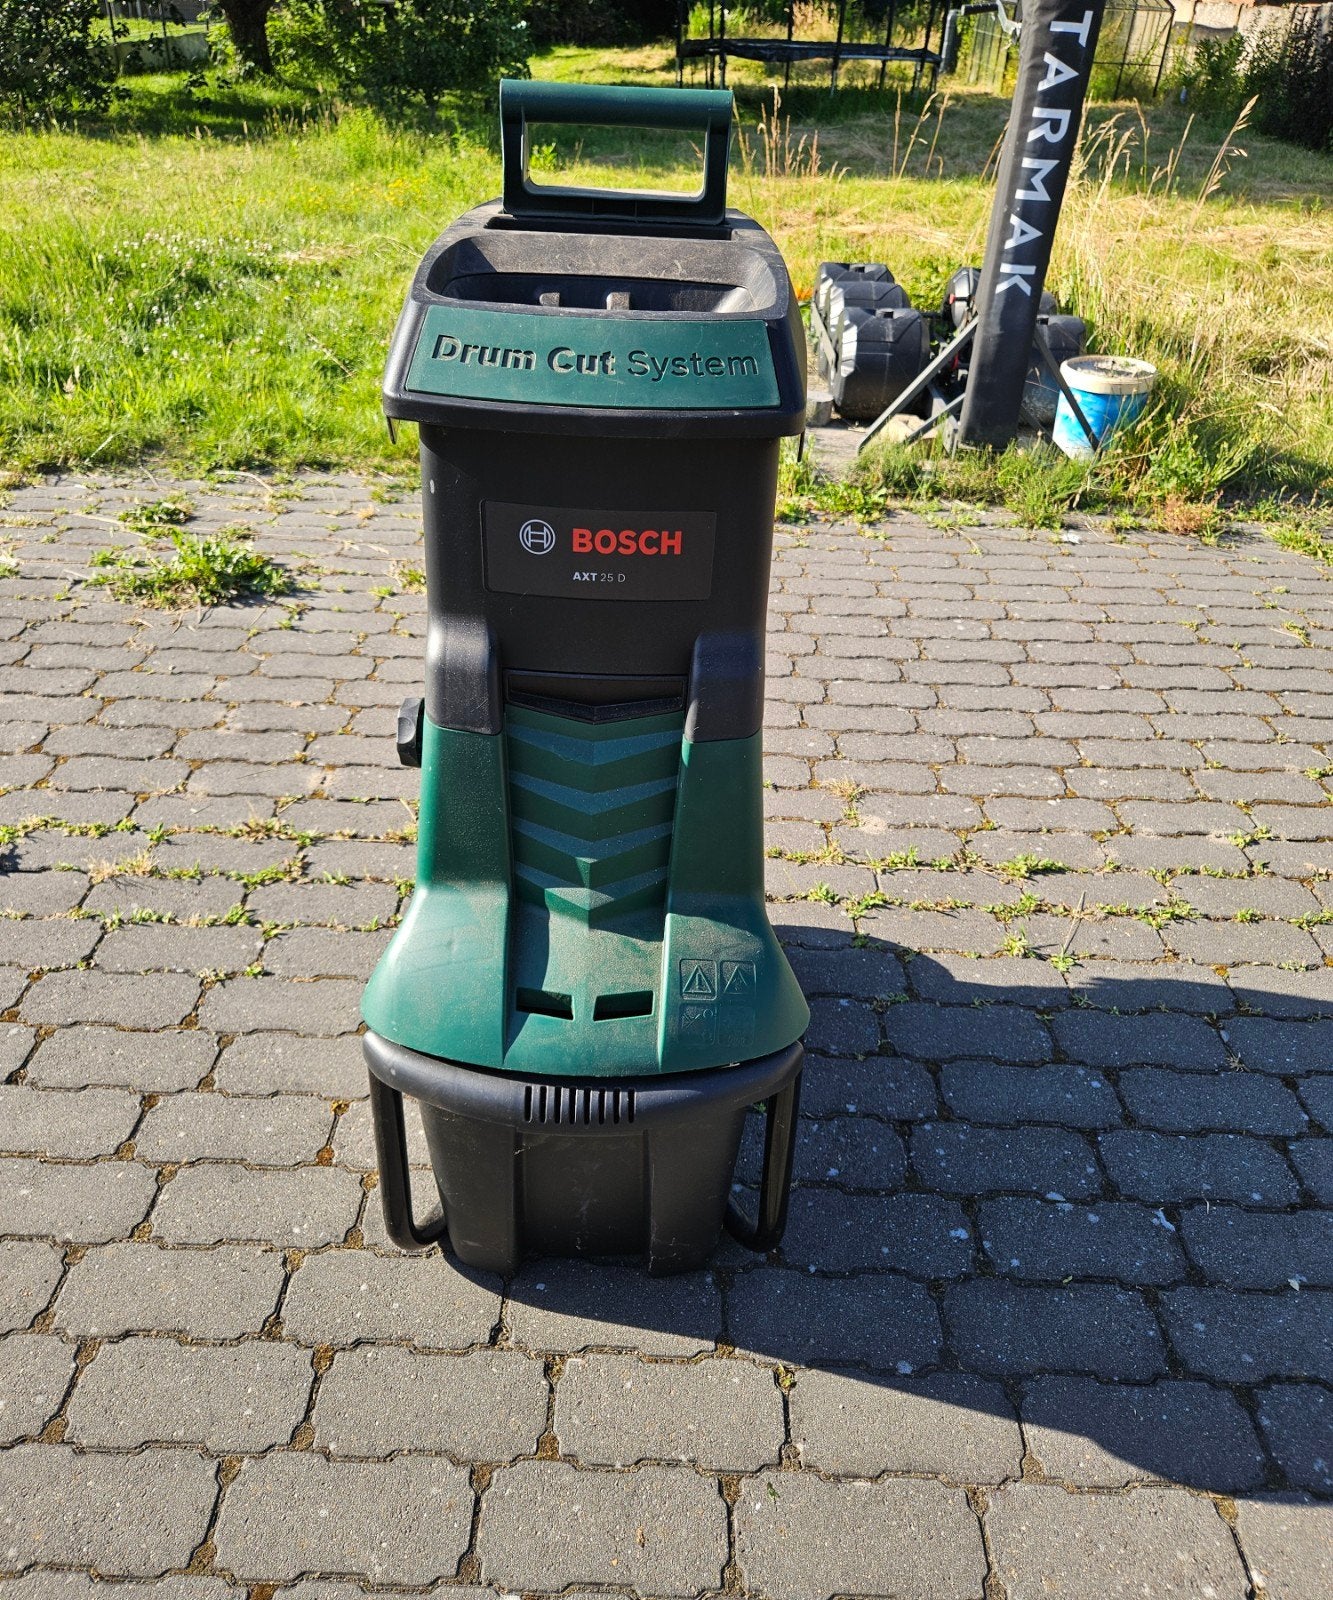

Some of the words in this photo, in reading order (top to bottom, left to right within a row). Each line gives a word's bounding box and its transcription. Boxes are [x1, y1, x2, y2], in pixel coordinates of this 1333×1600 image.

[995, 10, 1093, 296] TARMAK
[432, 334, 536, 371] Drum
[547, 347, 617, 376] Cut
[627, 350, 759, 382] System
[572, 528, 682, 555] BOSCH
[573, 572, 598, 582] AXT
[600, 573, 614, 583] 25
[618, 573, 626, 583] D
